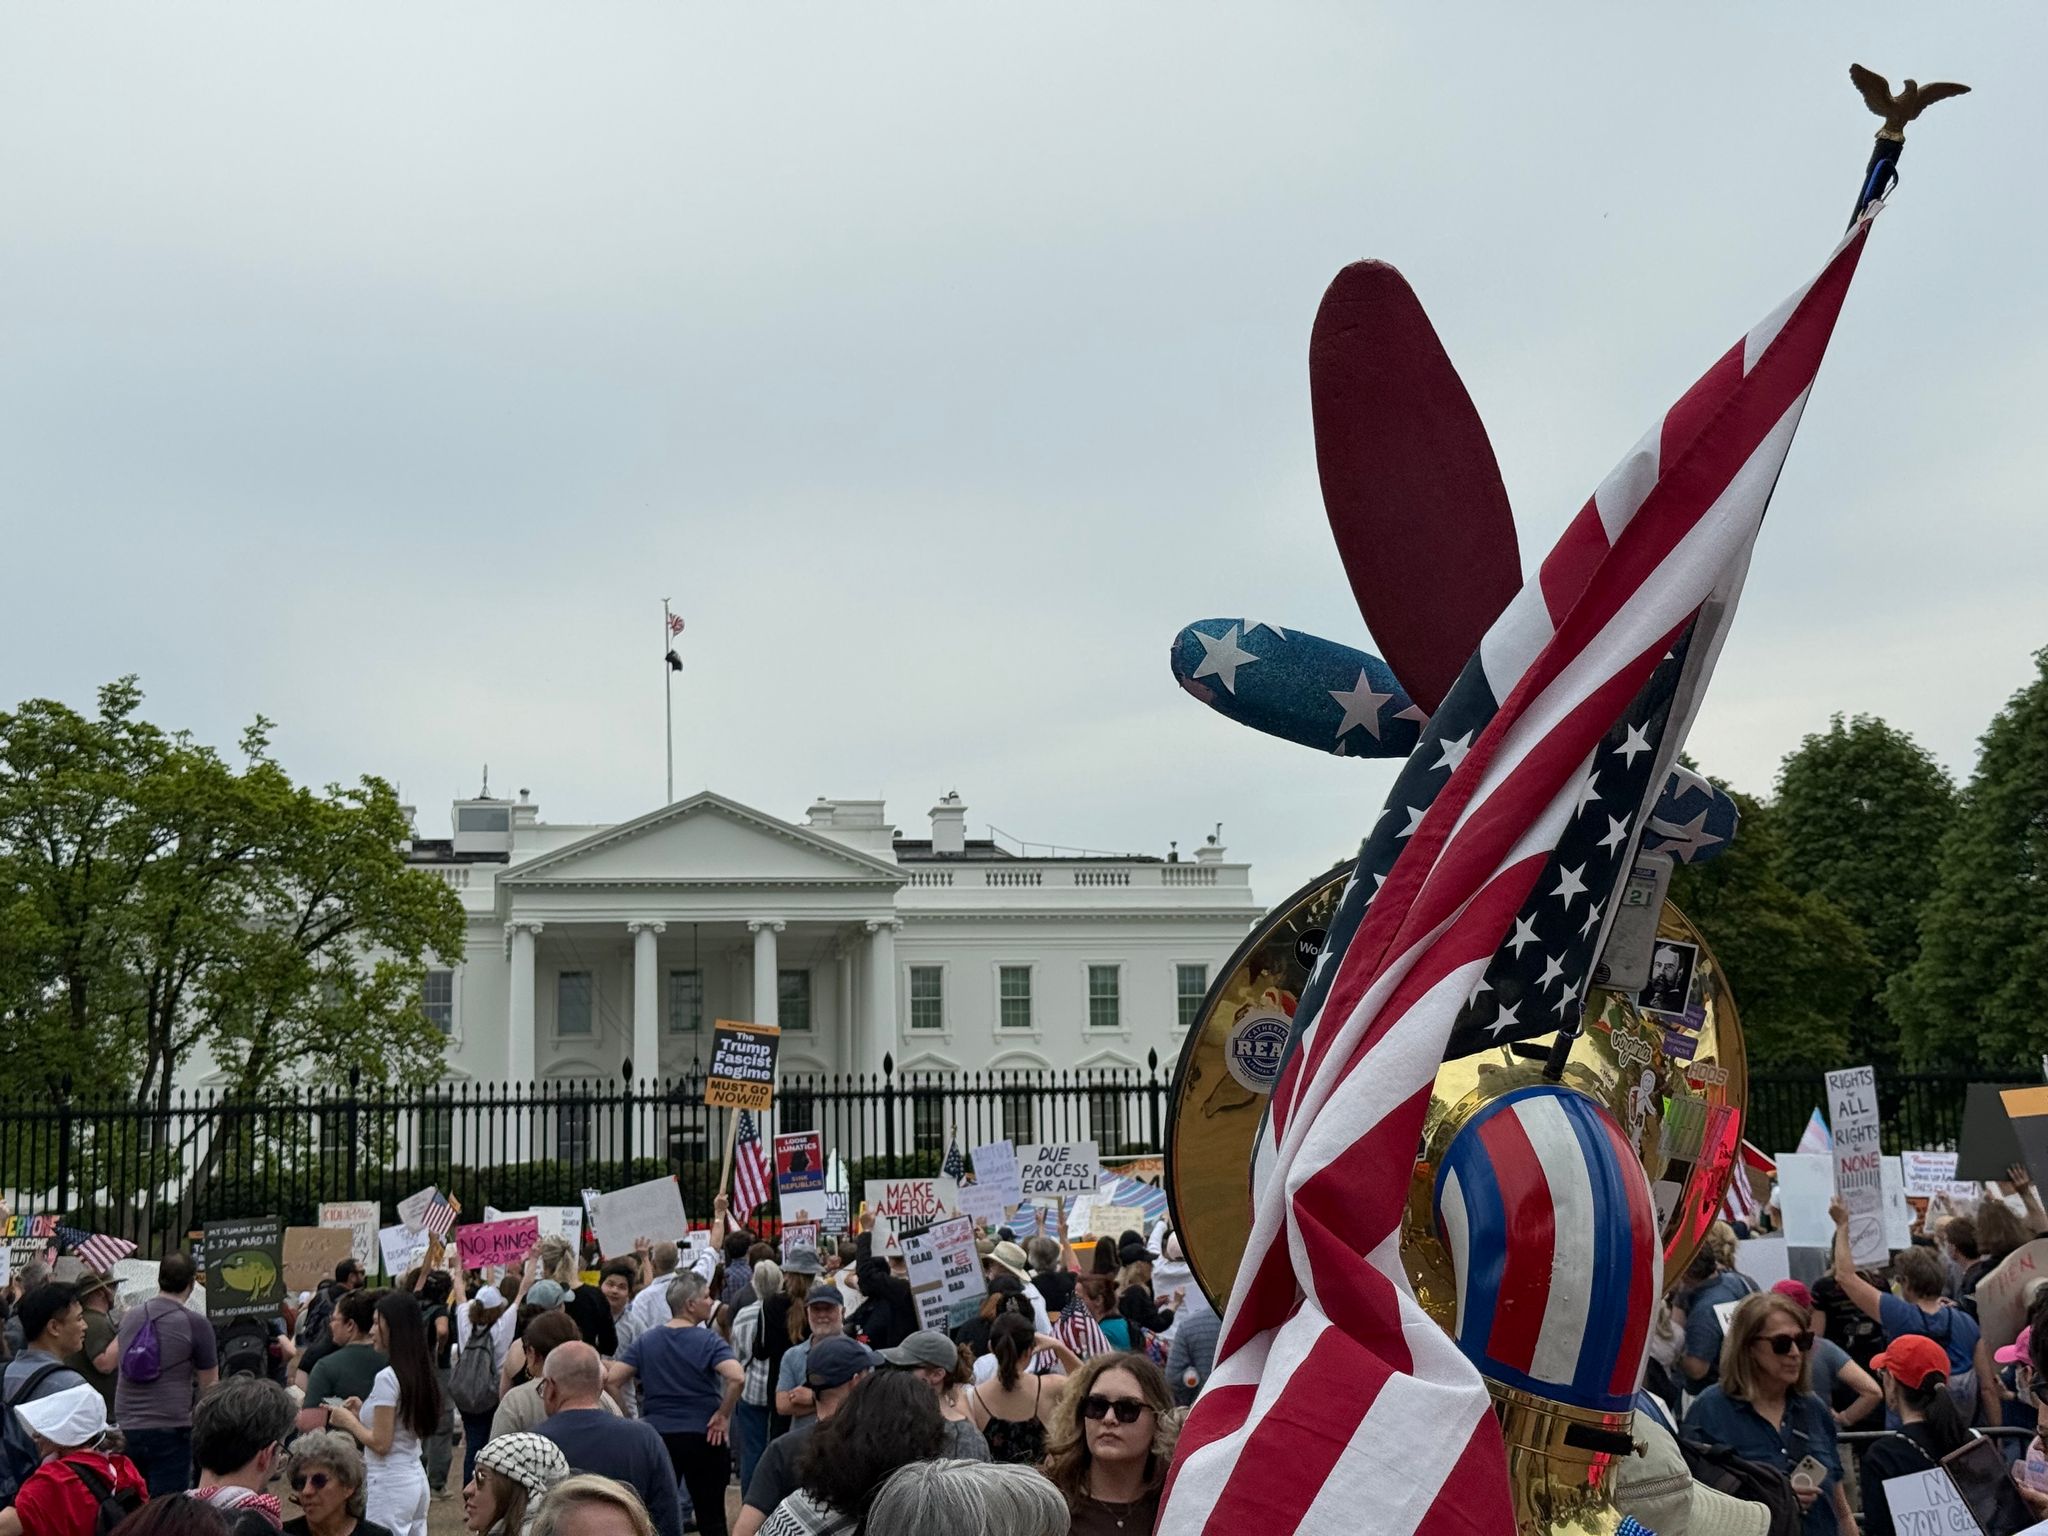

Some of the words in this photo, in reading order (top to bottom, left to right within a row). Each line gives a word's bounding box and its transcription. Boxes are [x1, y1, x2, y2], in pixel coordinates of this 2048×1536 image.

[736, 1032, 755, 1042] The
[1247, 1024, 1288, 1040] CATHERIN
[720, 1038, 771, 1057] Trump
[1236, 1040, 1283, 1058] REA
[715, 1050, 772, 1068] Fascist
[713, 1062, 771, 1080] Regime
[1688, 1062, 1728, 1084] HOOS
[1828, 1069, 1873, 1091] RIGHTS
[711, 1081, 747, 1092] MUST
[750, 1085, 769, 1096] GO
[713, 1091, 764, 1106] NOW!!!
[1839, 1097, 1870, 1118] ALL
[784, 1137, 808, 1146] LOOSE
[1835, 1124, 1878, 1147] RIGHTS
[778, 1143, 817, 1153] LUNATICS
[1038, 1146, 1071, 1162] DUE
[1841, 1151, 1880, 1174] NONE
[1021, 1163, 1089, 1179] PROCESS
[886, 1182, 934, 1199] MAKE
[826, 1191, 846, 1211] NO!
[875, 1198, 946, 1216] AMERICA
[11, 1237, 49, 1250] WELCOME
[219, 1238, 237, 1248] I'M
[240, 1236, 263, 1247] MAD
[265, 1234, 278, 1244] AT
[459, 1235, 486, 1256] NO
[493, 1229, 538, 1252] KINGS
[906, 1238, 920, 1250] I'M
[20, 1251, 33, 1264] MY
[479, 1253, 500, 1265] 250
[910, 1251, 933, 1265] GLAD
[941, 1252, 953, 1265] MY
[944, 1263, 973, 1279] RACIST
[948, 1280, 965, 1292] DAD
[210, 1308, 225, 1317] THE
[226, 1303, 279, 1314] GOVERNMENT
[1898, 1509, 1943, 1536] YOU
[1947, 1503, 1978, 1532] CA
